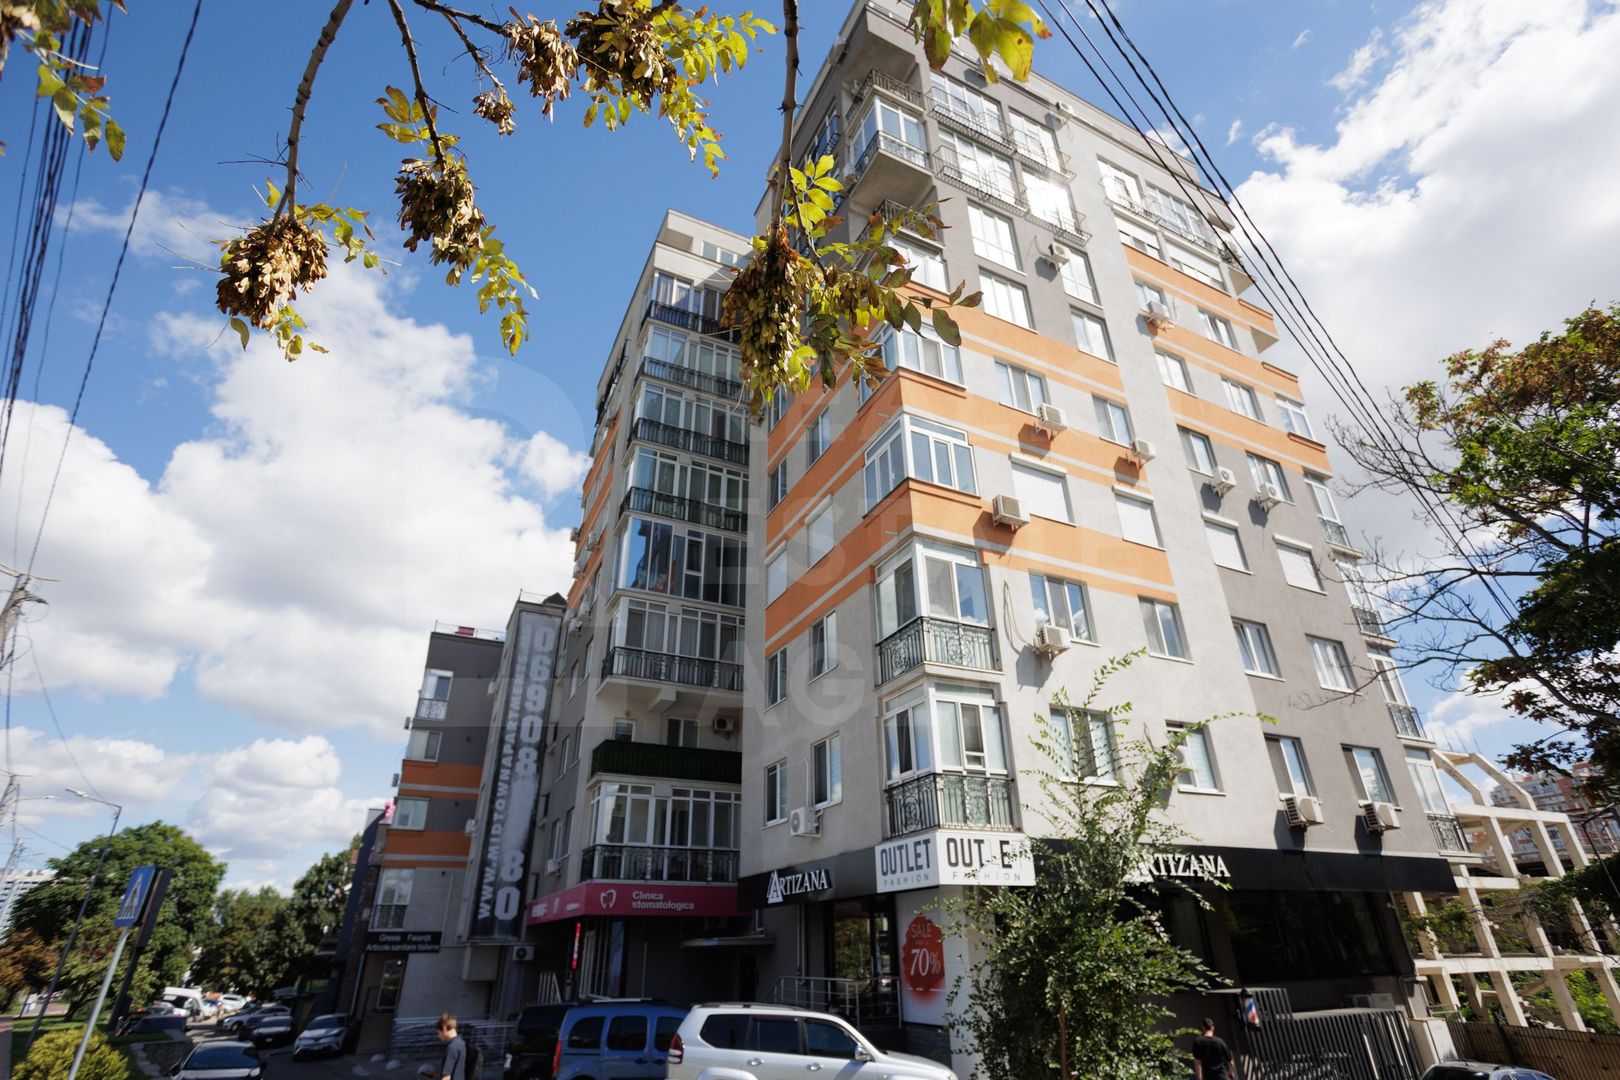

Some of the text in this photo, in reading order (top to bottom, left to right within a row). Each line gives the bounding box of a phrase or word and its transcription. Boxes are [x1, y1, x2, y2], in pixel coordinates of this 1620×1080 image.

[494, 626, 556, 921] 0690880
[880, 838, 931, 876] OUTLET
[767, 868, 829, 904] ARTIZANA
[883, 873, 930, 887] FASHION
[632, 891, 664, 900] Clinica
[911, 923, 933, 938] SALE
[910, 947, 941, 976] 70%
